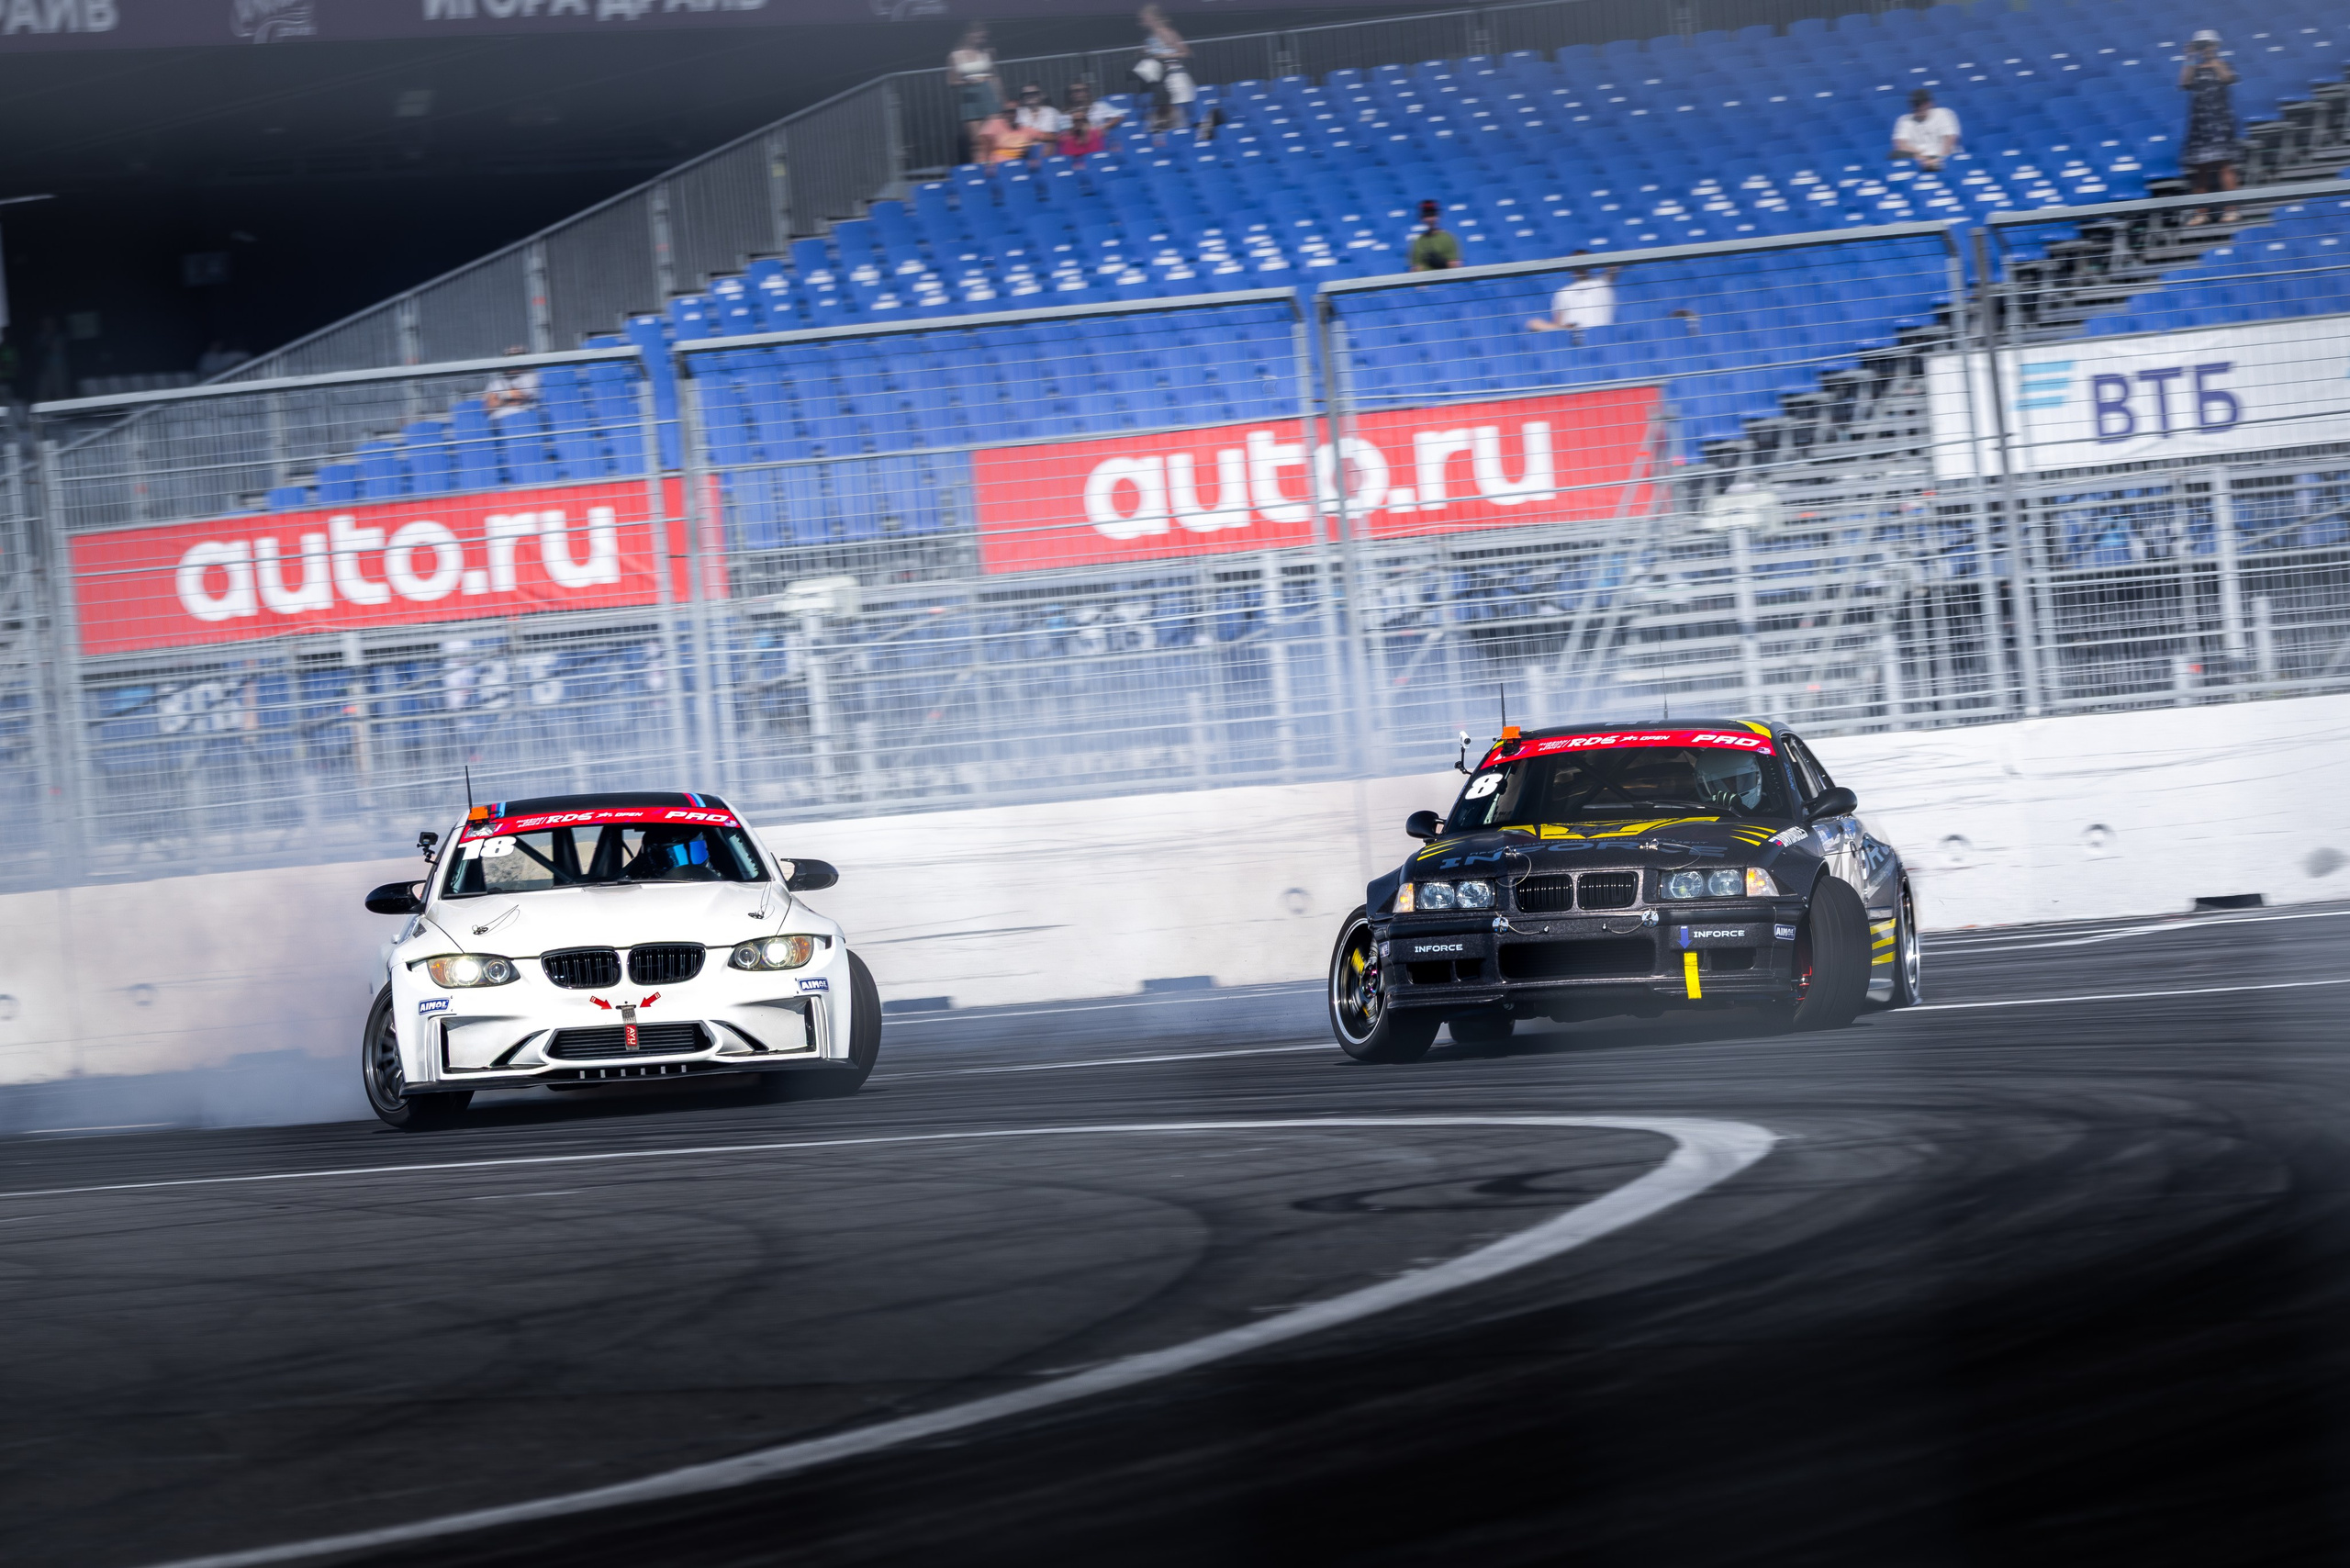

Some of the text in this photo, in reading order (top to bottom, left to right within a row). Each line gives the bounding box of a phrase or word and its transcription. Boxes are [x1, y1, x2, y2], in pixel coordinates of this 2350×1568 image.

[2089, 361, 2244, 444] ВТБ
[1083, 421, 1555, 540] auto.ru
[174, 507, 621, 621] auto.ru
[1691, 734, 1761, 747] PRO
[1465, 773, 1504, 800] 8
[665, 811, 729, 823] PRO
[458, 835, 517, 860] 18
[1693, 930, 1745, 938] INFORCE
[1415, 944, 1463, 953] INFORCE
[420, 1001, 449, 1013] AIMOL
